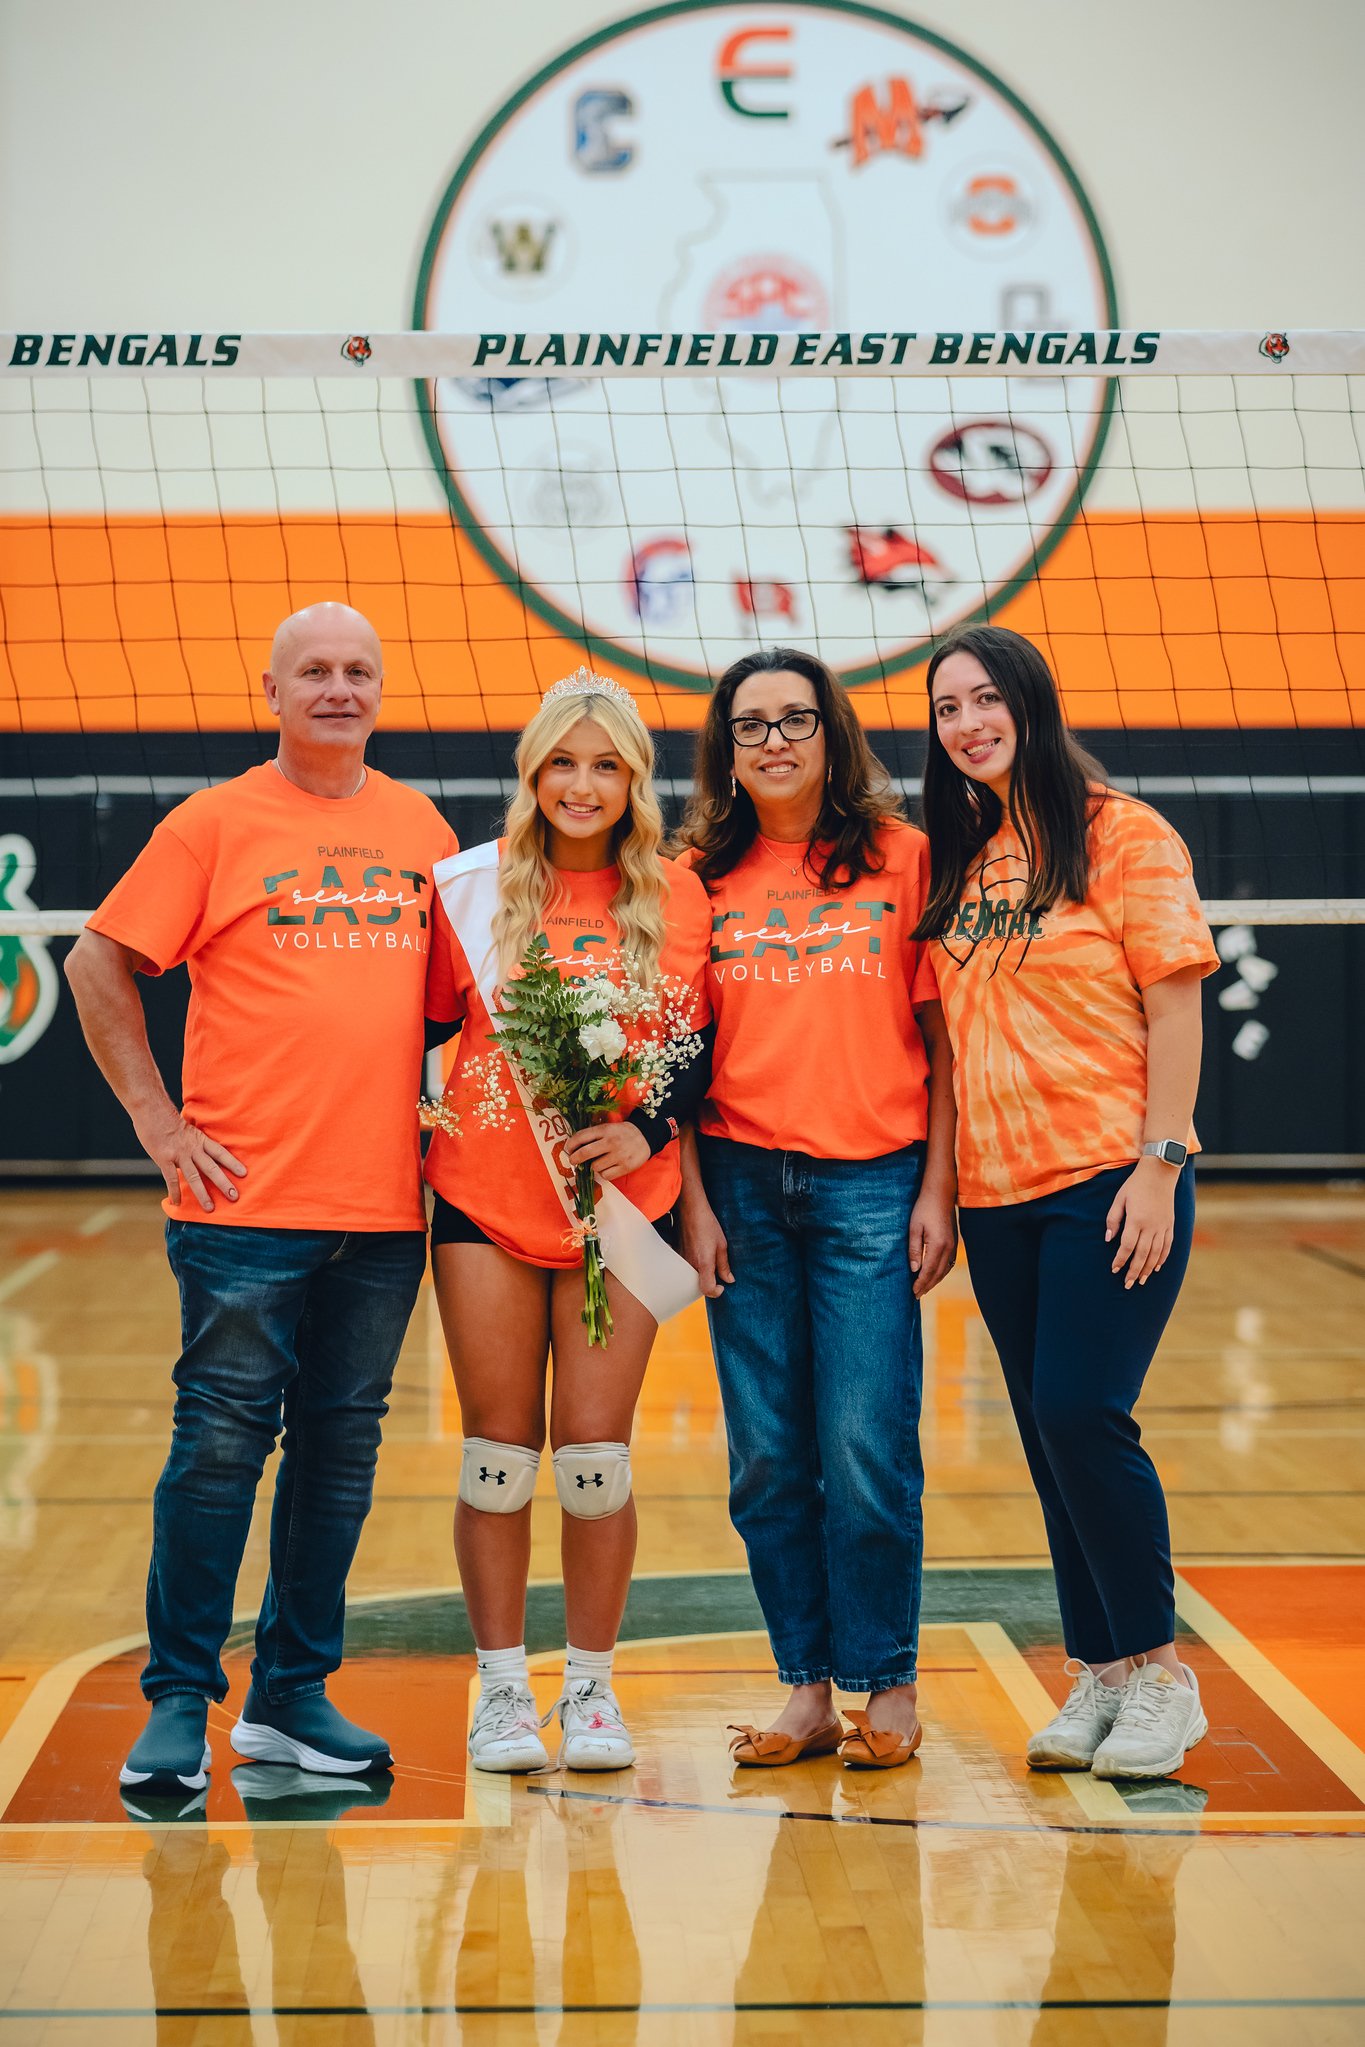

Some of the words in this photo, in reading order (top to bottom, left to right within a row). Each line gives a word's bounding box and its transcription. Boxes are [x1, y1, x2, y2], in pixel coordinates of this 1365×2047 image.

[8, 334, 242, 368] BENGALS
[472, 333, 778, 367] PLAINFIELD
[789, 332, 917, 366] EAST
[928, 331, 1161, 365] BENGALS
[317, 846, 385, 860] PLAINFIELD
[263, 866, 428, 929] EAST
[292, 887, 417, 906] senior
[767, 889, 841, 901] PLAINFIELD
[541, 916, 604, 929] AINFIELD
[710, 901, 897, 964] EAST
[733, 921, 871, 943] senior
[273, 932, 427, 954] VOLLEYBALL
[714, 956, 887, 985] VOLLEYBALL
[538, 1114, 566, 1143] 20
